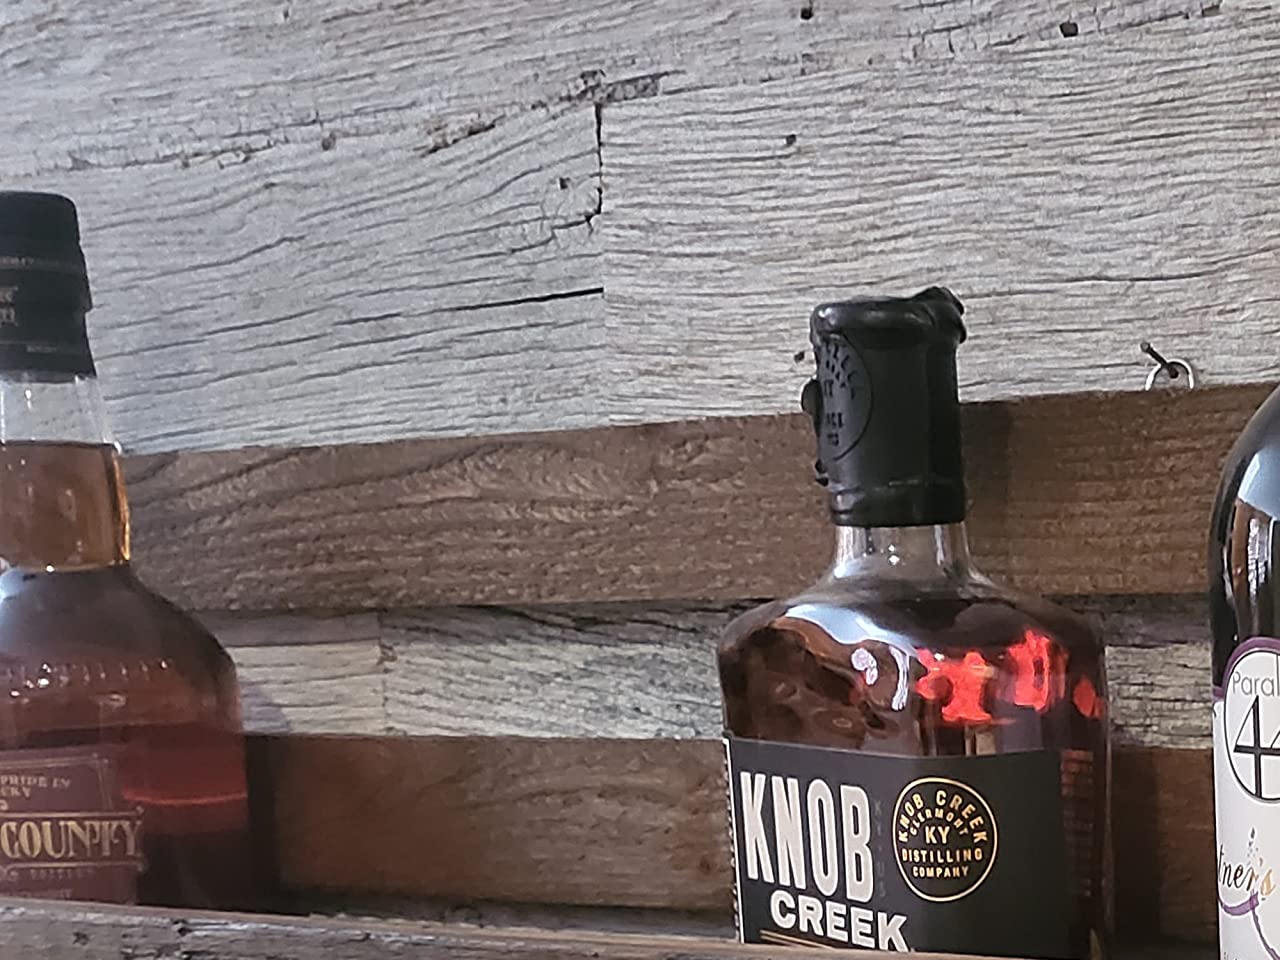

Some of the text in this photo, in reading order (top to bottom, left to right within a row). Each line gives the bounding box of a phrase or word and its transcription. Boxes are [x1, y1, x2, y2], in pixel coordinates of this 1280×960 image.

[898, 790, 988, 844] KNOB CREEK
[909, 807, 969, 836] CLERMONT
[0, 820, 142, 859] COUNTY
[740, 771, 874, 903] KNOB
[925, 825, 950, 844] KY
[901, 848, 983, 863] DISTILLING
[912, 866, 969, 878] COMPANY
[769, 889, 910, 952] CREEK
